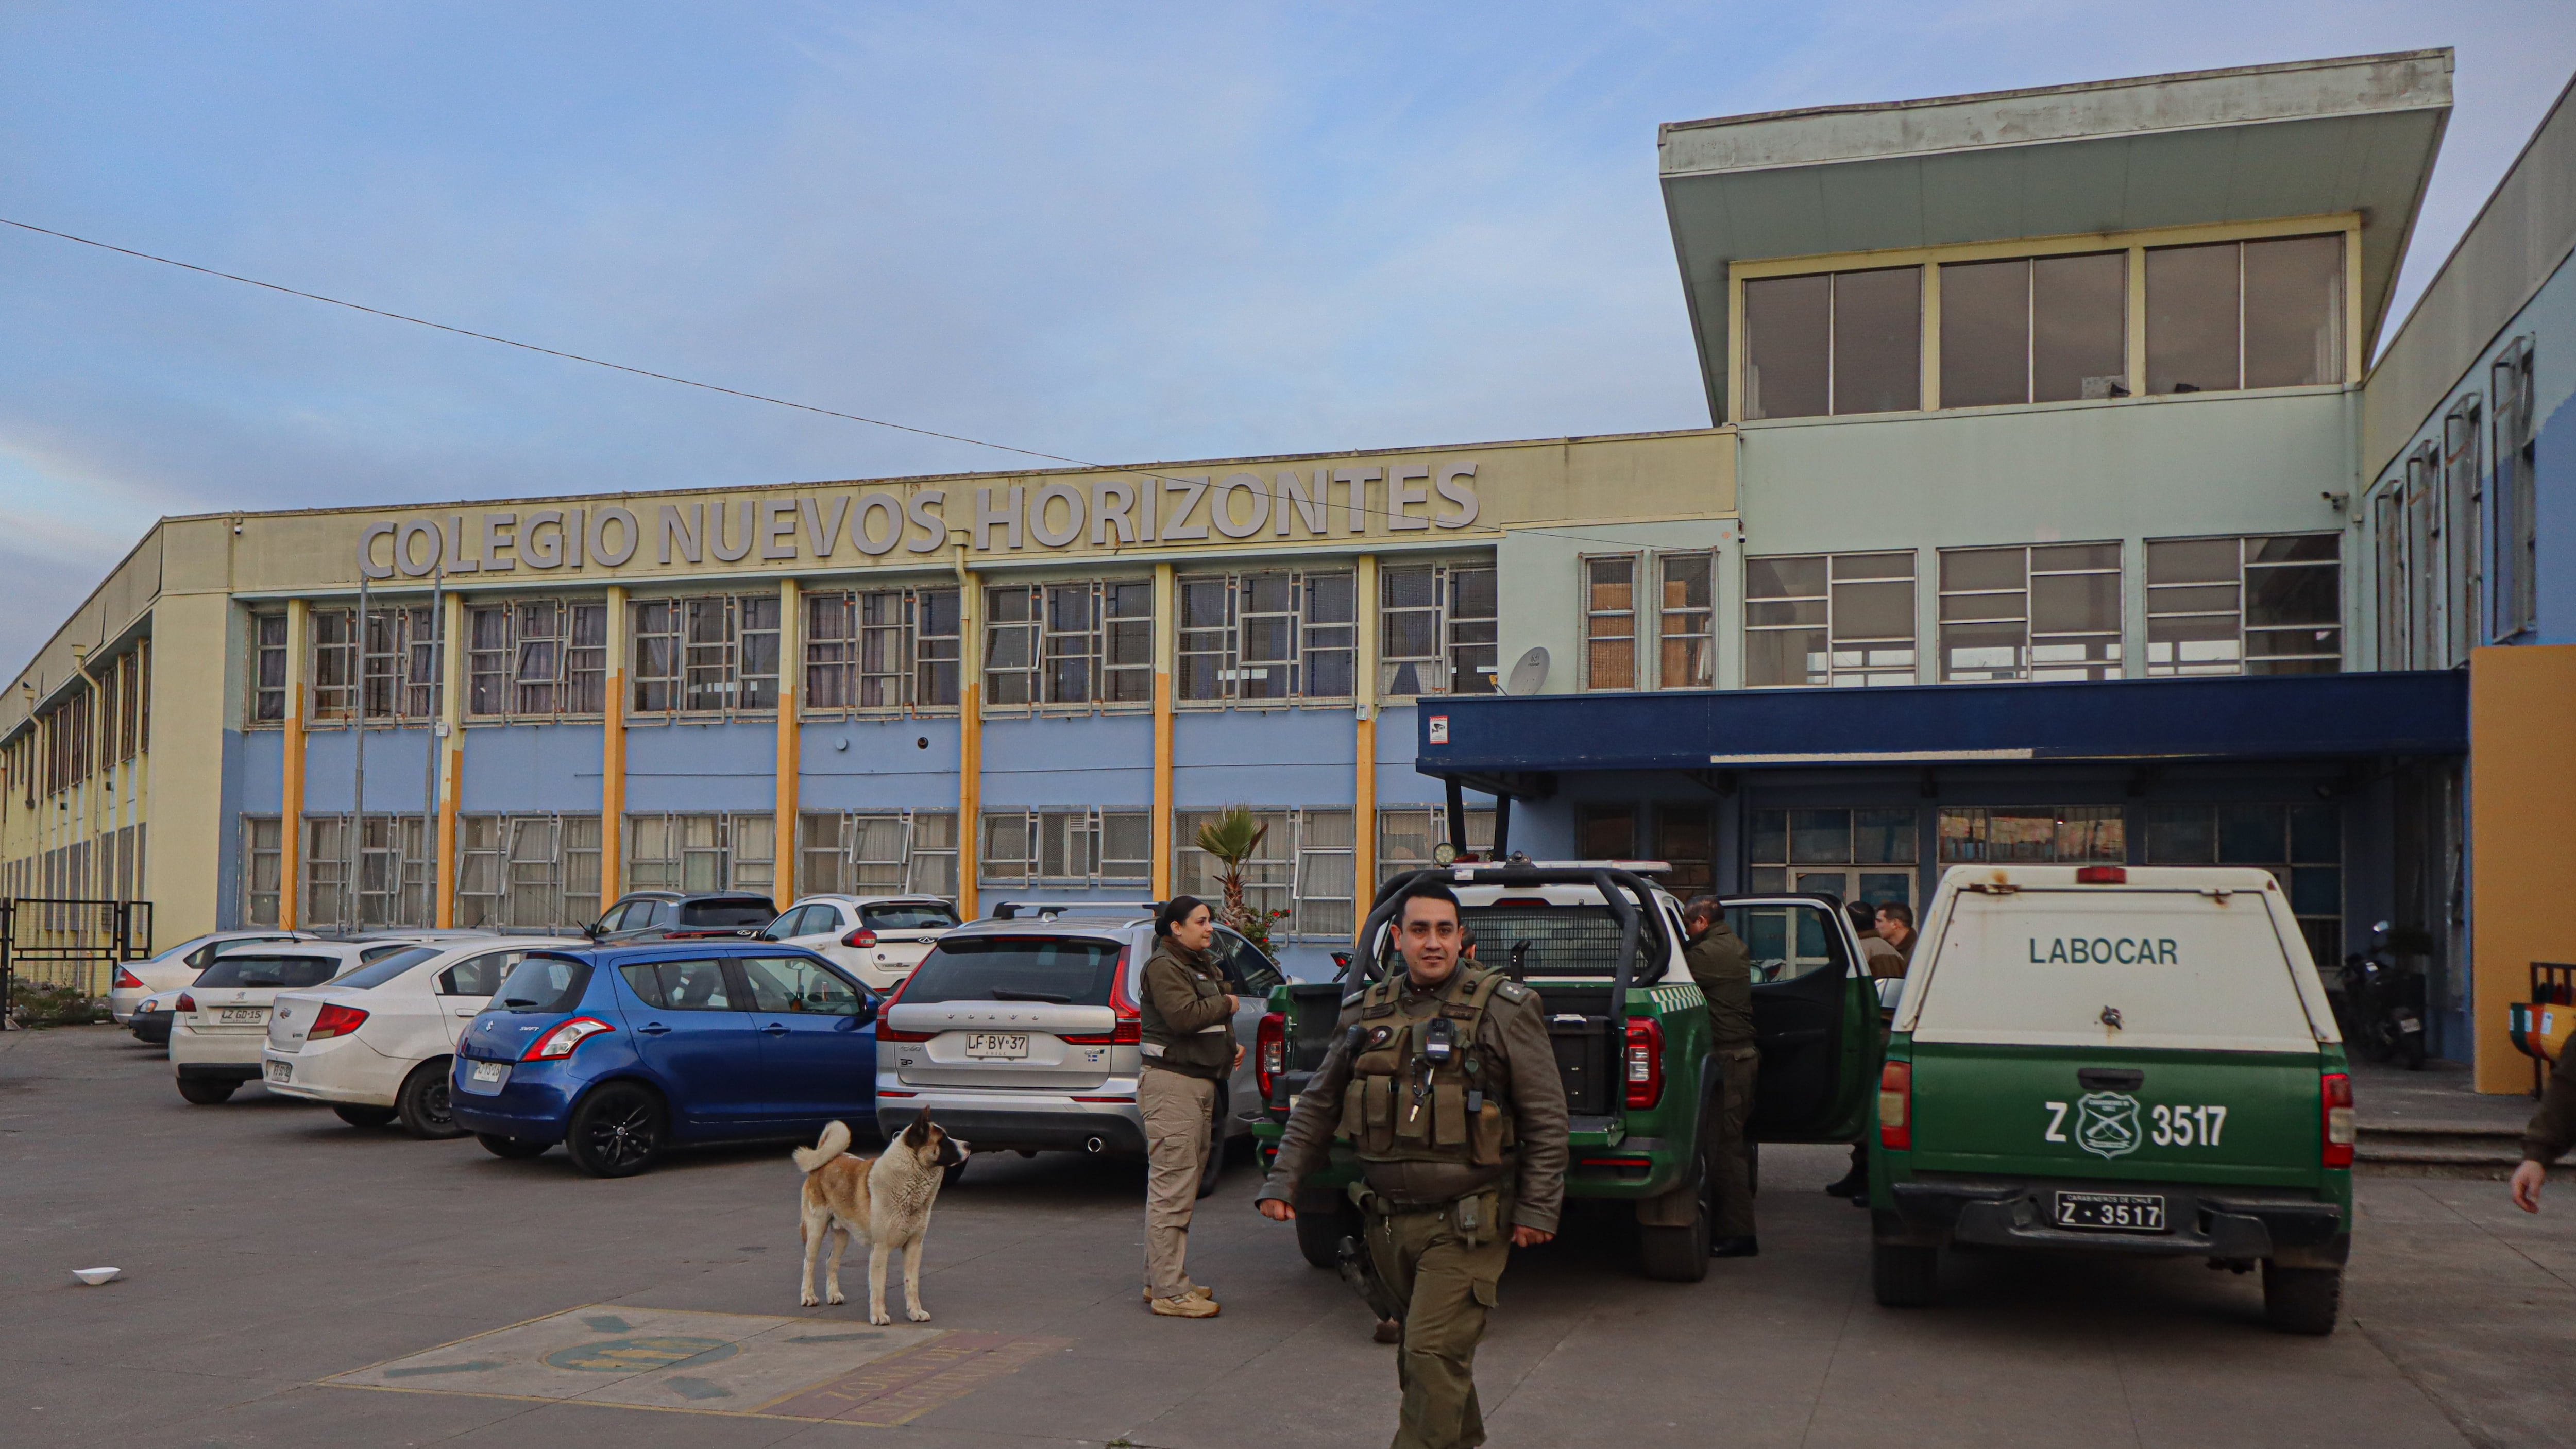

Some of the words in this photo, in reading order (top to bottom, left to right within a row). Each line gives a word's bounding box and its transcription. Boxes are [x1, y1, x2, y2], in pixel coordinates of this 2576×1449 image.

[357, 506, 638, 578] COLEGIO
[658, 490, 946, 564] NUEVOS
[976, 461, 1480, 550] HORIZONTES
[2030, 937, 2177, 965] LABOCAR
[2045, 1101, 2068, 1143] Z
[2151, 1104, 2227, 1146] 3517
[2062, 1202, 2076, 1223] Z
[2100, 1204, 2159, 1226] 3517
